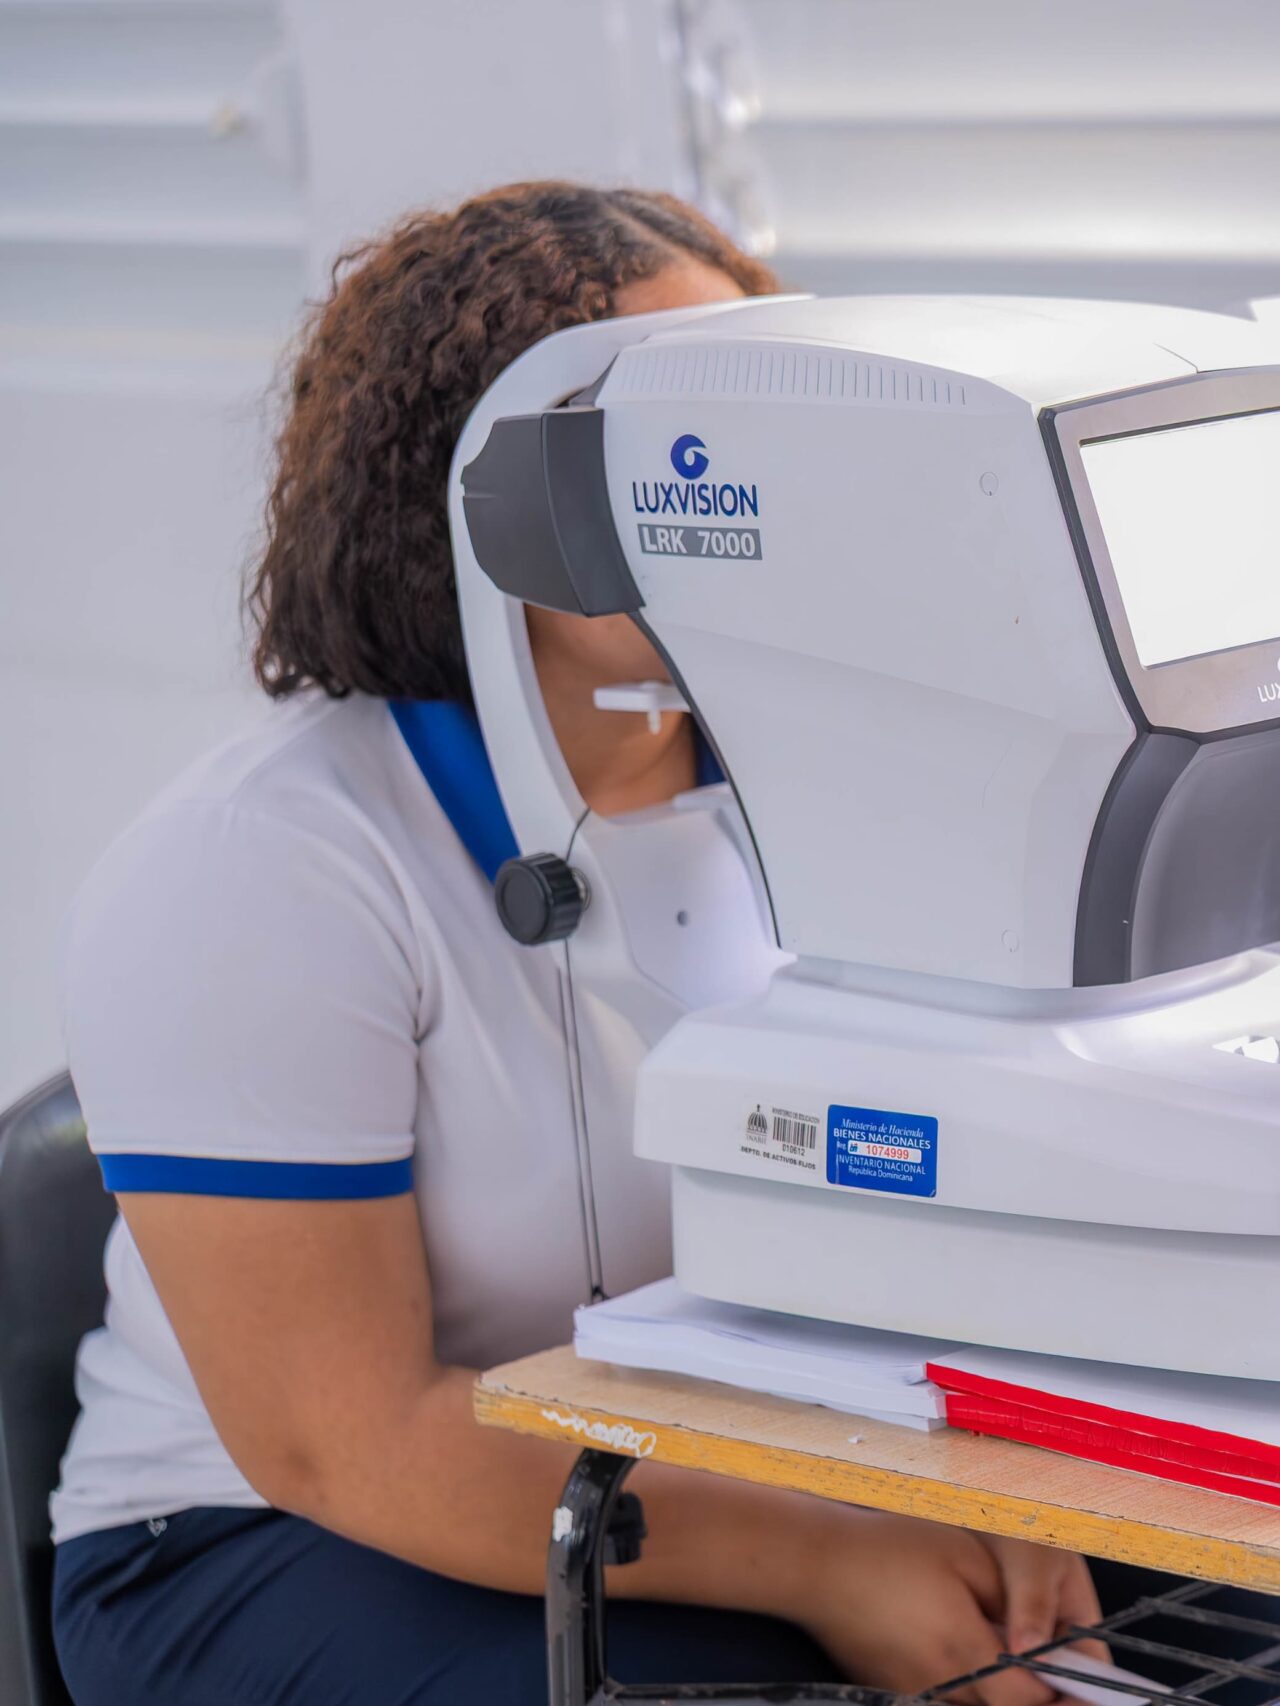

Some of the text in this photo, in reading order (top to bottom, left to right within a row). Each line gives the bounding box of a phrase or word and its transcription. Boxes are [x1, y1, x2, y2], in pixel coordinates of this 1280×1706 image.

[632, 481, 759, 517] LUXVISION
[642, 526, 756, 557] LRK 7000
[833, 1128, 931, 1149] BIENES NACIONALES
[841, 1118, 924, 1138] Ministerio de Hacienda
[741, 1146, 816, 1170] DEPTO. DE ACTIVOS FIJOS
[782, 1144, 806, 1156] 010612
[866, 1144, 909, 1159] 1074999
[836, 1154, 926, 1175] INVENTARIO NACIONAL
[878, 1169, 913, 1182] Dominicana
